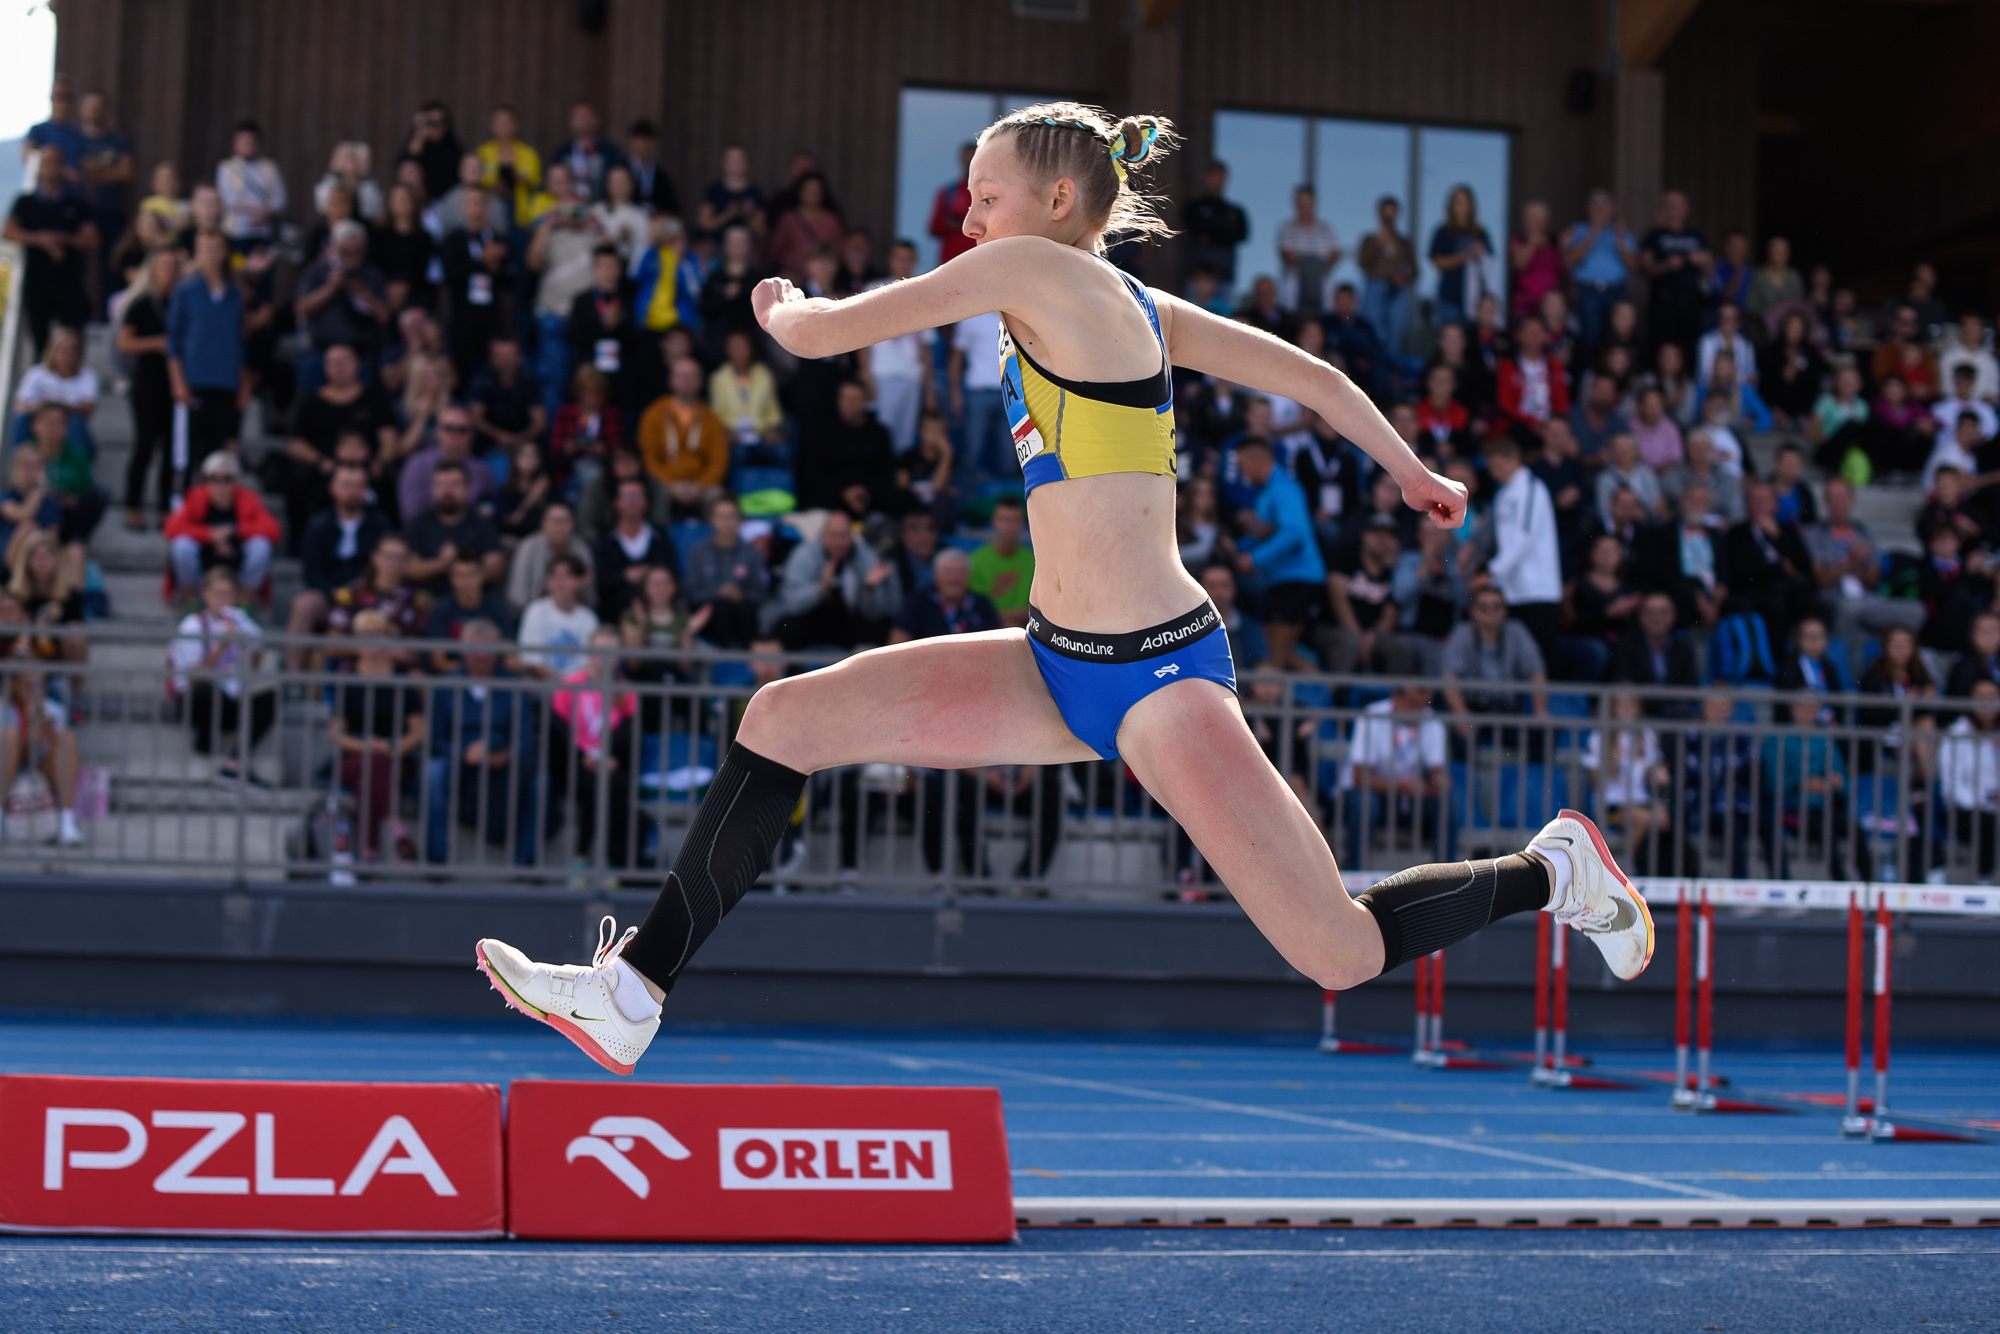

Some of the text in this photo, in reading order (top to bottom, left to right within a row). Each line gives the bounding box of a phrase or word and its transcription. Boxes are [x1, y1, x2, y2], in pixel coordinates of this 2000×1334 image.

[1050, 633, 1114, 656] AdRunaLine
[1140, 610, 1215, 652] AdRunaLine
[43, 1107, 459, 1196] PZLA
[733, 1138, 935, 1180] ORLEN
